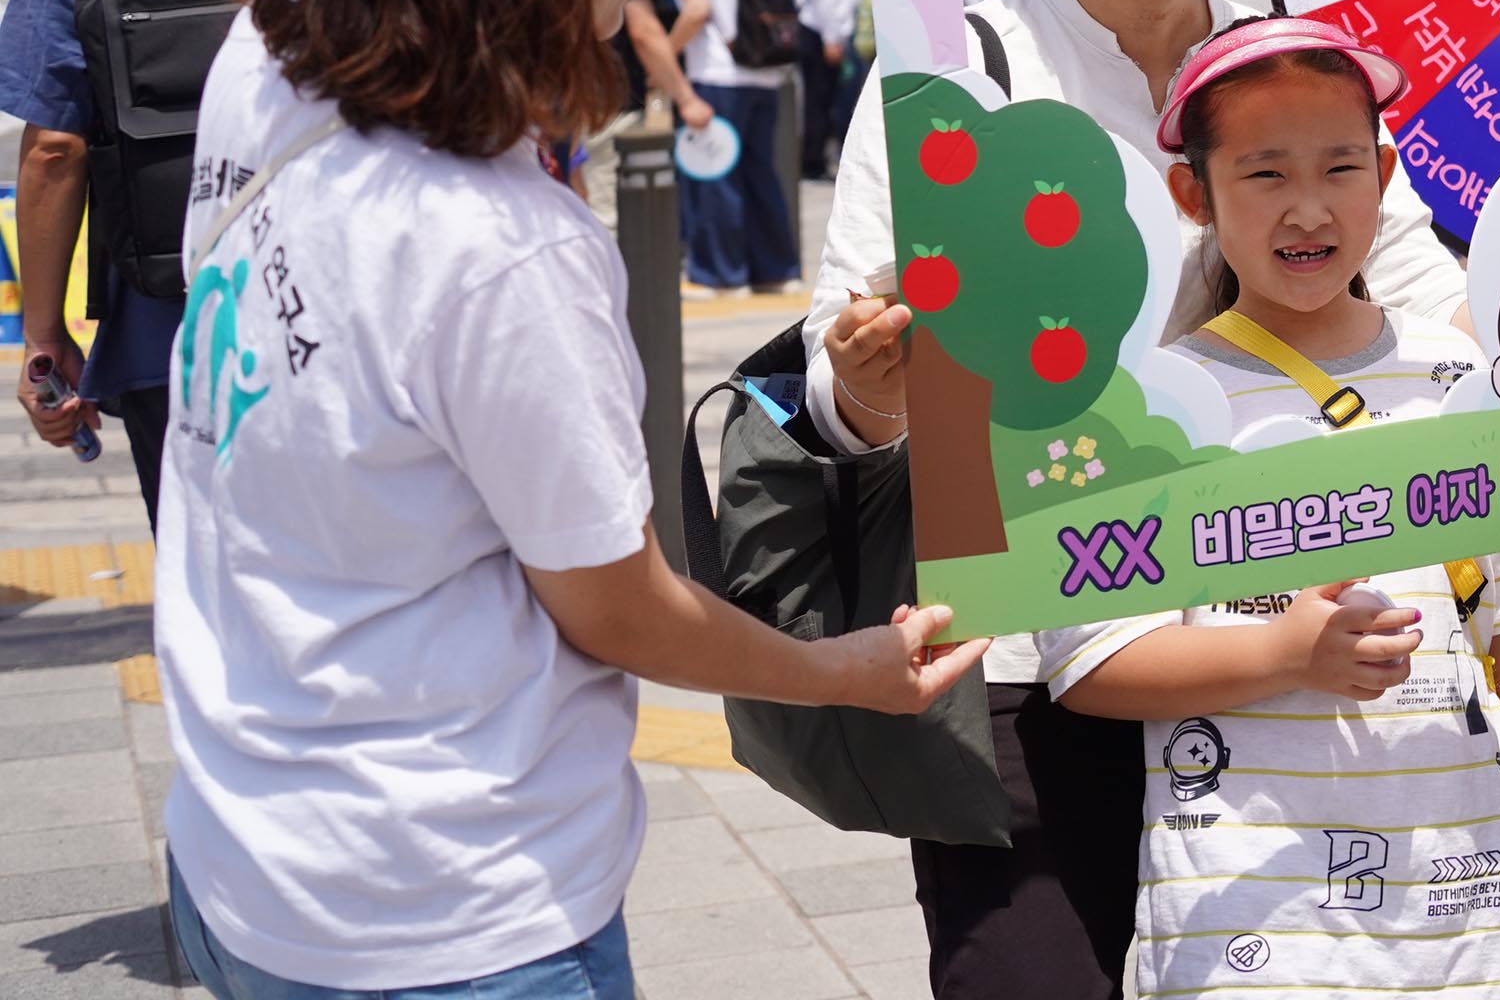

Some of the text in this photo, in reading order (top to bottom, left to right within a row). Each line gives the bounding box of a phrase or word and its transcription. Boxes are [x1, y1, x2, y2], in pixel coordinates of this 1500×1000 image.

[1057, 463, 1496, 597] XX 비밀암호 여자
[1428, 886, 1470, 902] NOTHING
